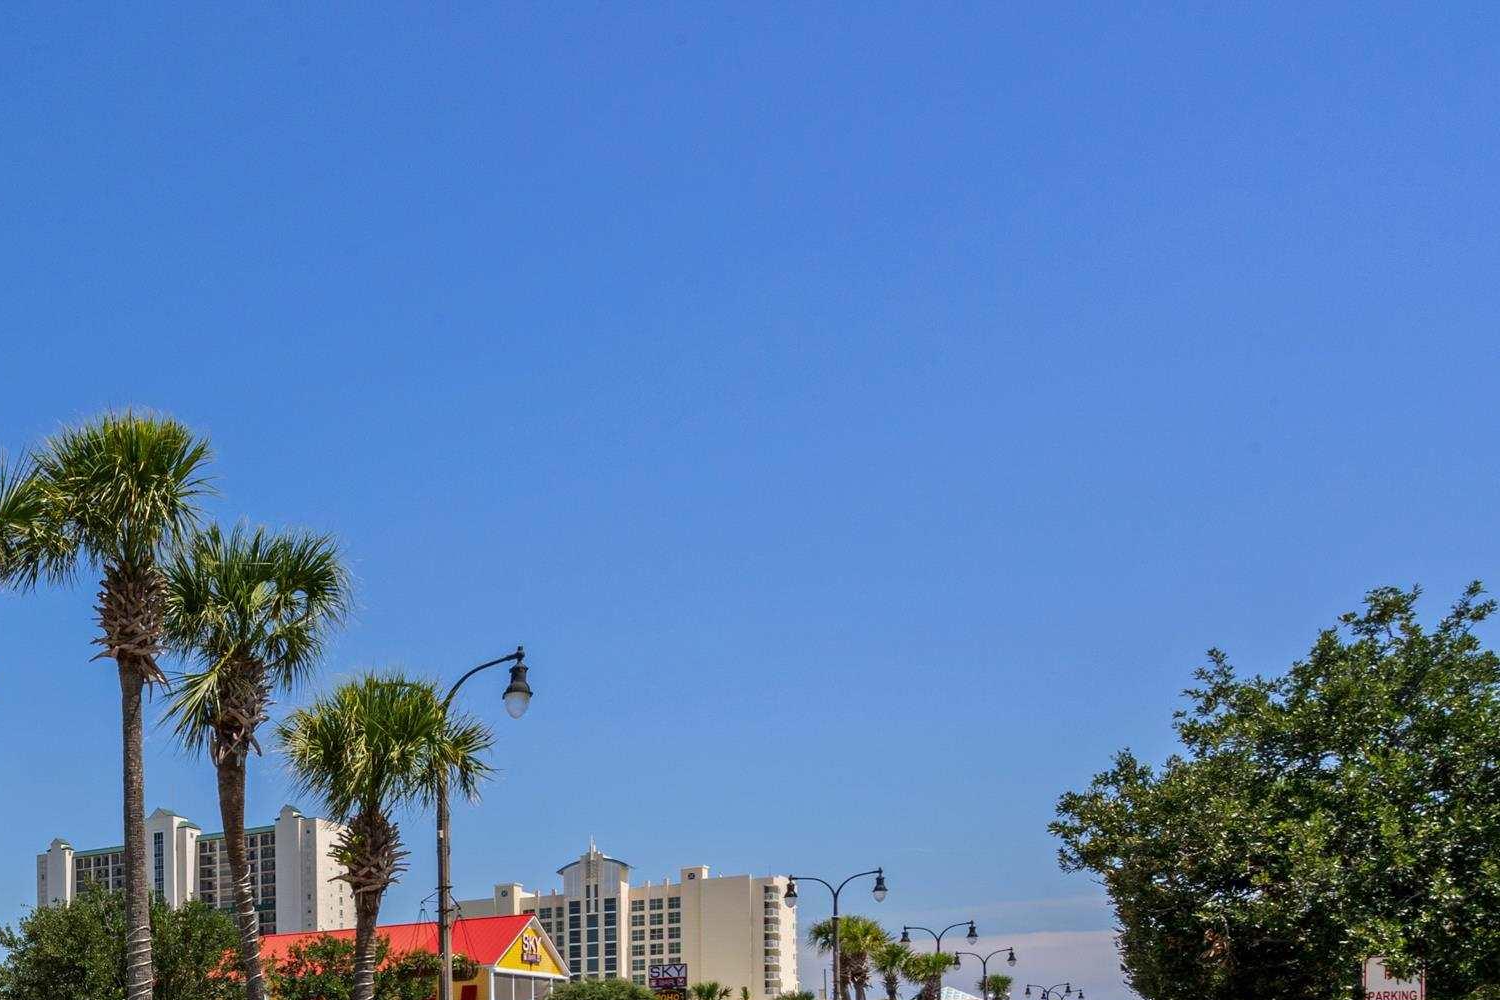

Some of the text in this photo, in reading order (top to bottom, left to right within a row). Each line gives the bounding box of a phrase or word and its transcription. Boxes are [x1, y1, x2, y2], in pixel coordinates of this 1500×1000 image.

[522, 934, 542, 953] SKY
[650, 965, 685, 978] SKY
[1368, 990, 1418, 1000] PARKING
